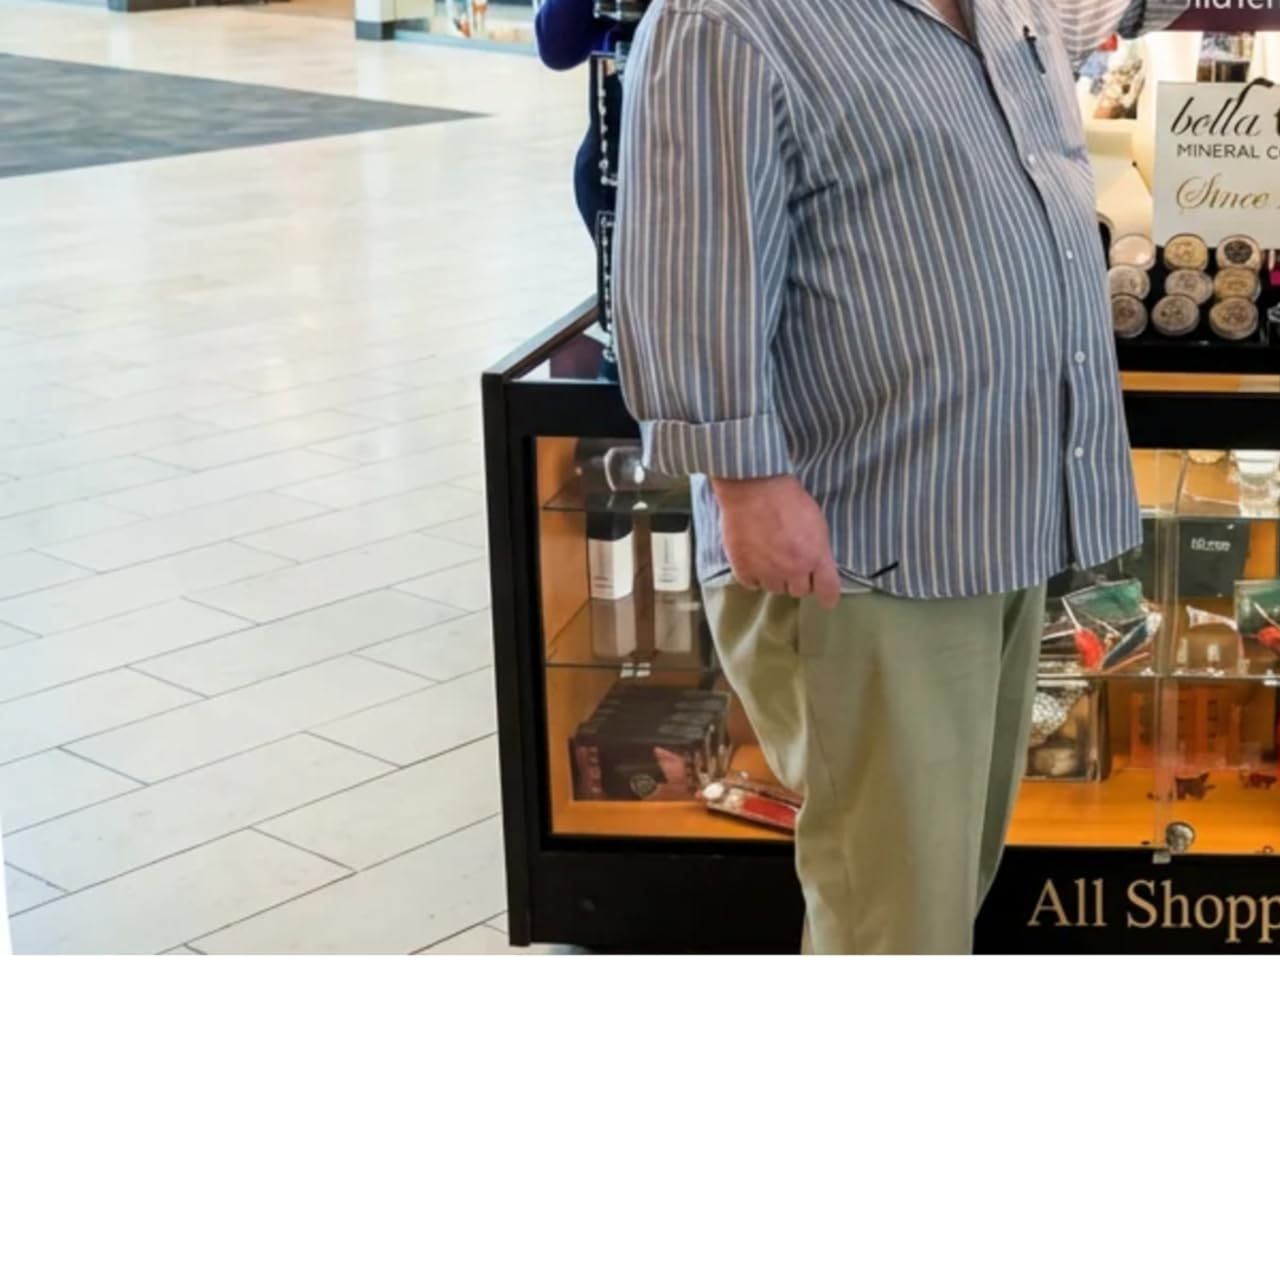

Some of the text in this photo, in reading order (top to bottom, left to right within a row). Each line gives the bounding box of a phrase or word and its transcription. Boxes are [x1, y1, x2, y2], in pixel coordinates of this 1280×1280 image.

[1170, 86, 1269, 137] bella
[1176, 144, 1260, 159] MINERAL
[1175, 172, 1270, 211] Since
[1027, 878, 1108, 927] All
